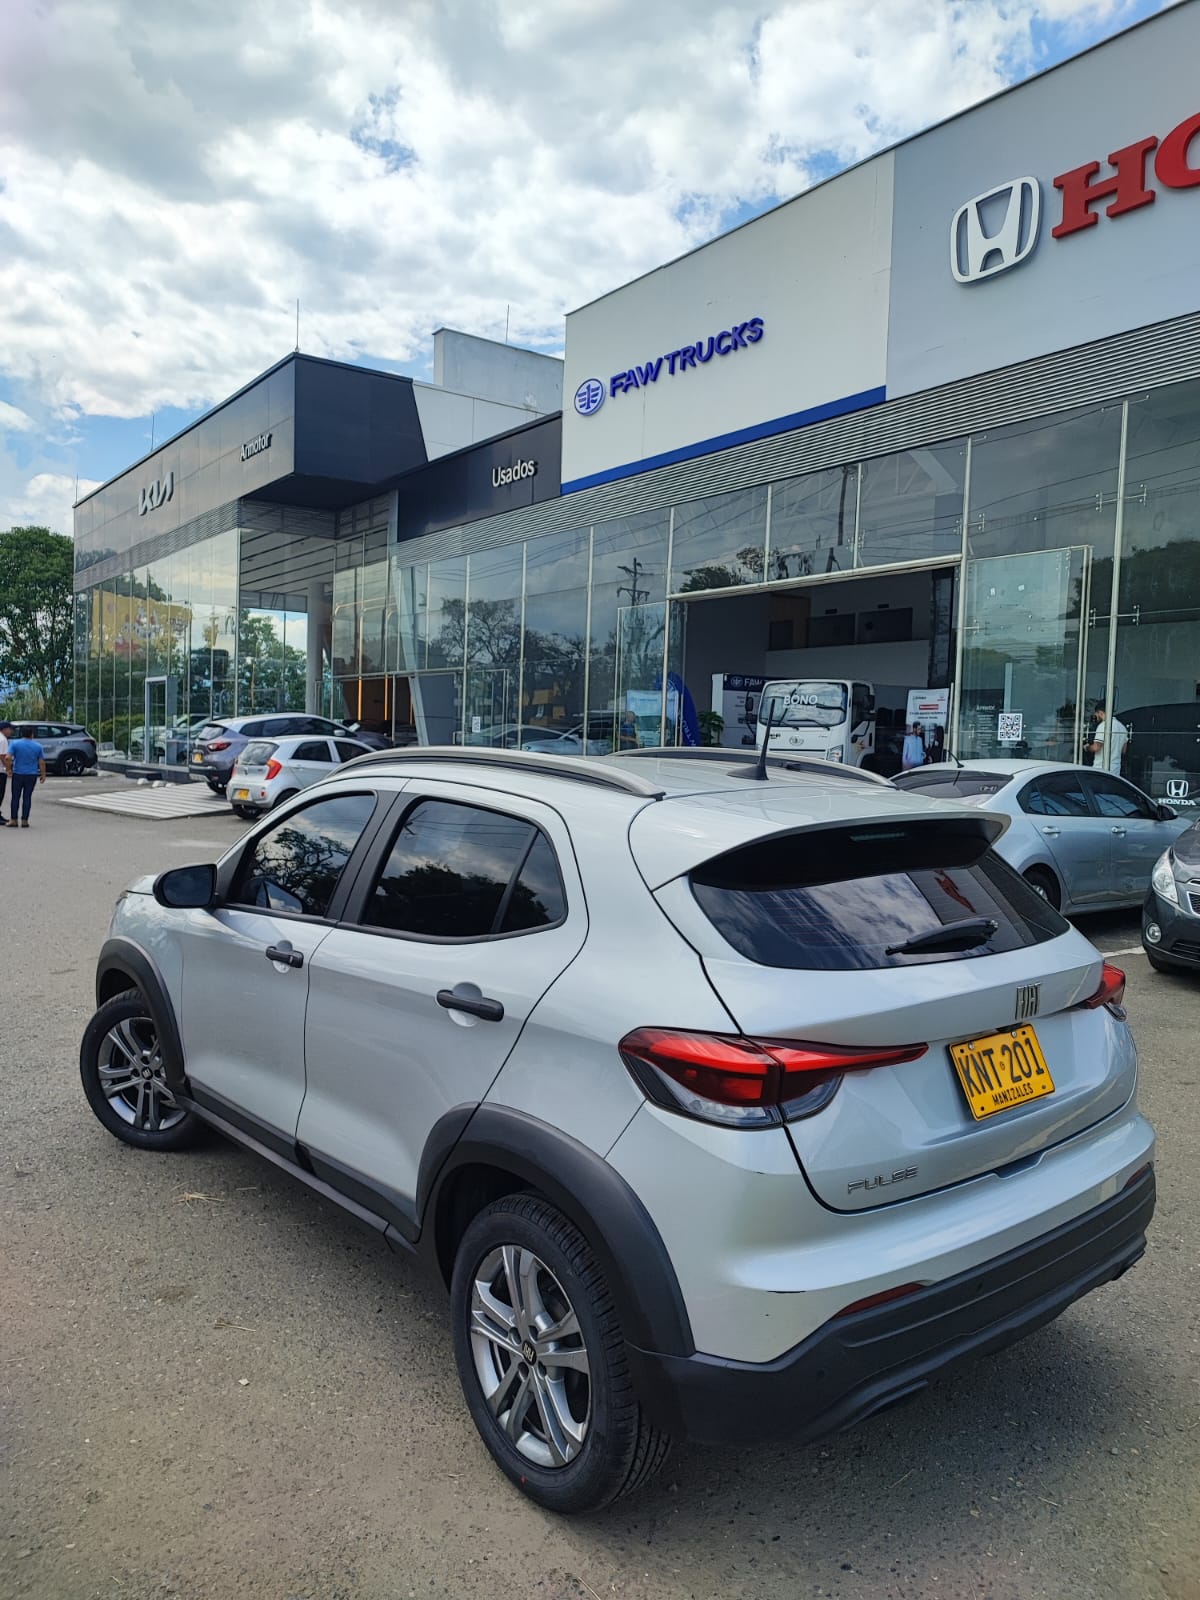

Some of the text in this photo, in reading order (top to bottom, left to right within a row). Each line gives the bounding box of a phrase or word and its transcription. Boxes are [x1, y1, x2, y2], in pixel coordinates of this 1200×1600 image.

[609, 317, 764, 397] FAW TRUCKS
[240, 433, 272, 461] Armotor
[492, 459, 536, 488] Usados
[783, 694, 818, 705] BONO
[1157, 798, 1196, 806] HONDA
[958, 1037, 1044, 1098] KNT 201
[992, 1082, 1034, 1106] MANIZALES
[847, 1165, 919, 1195] PULSE
